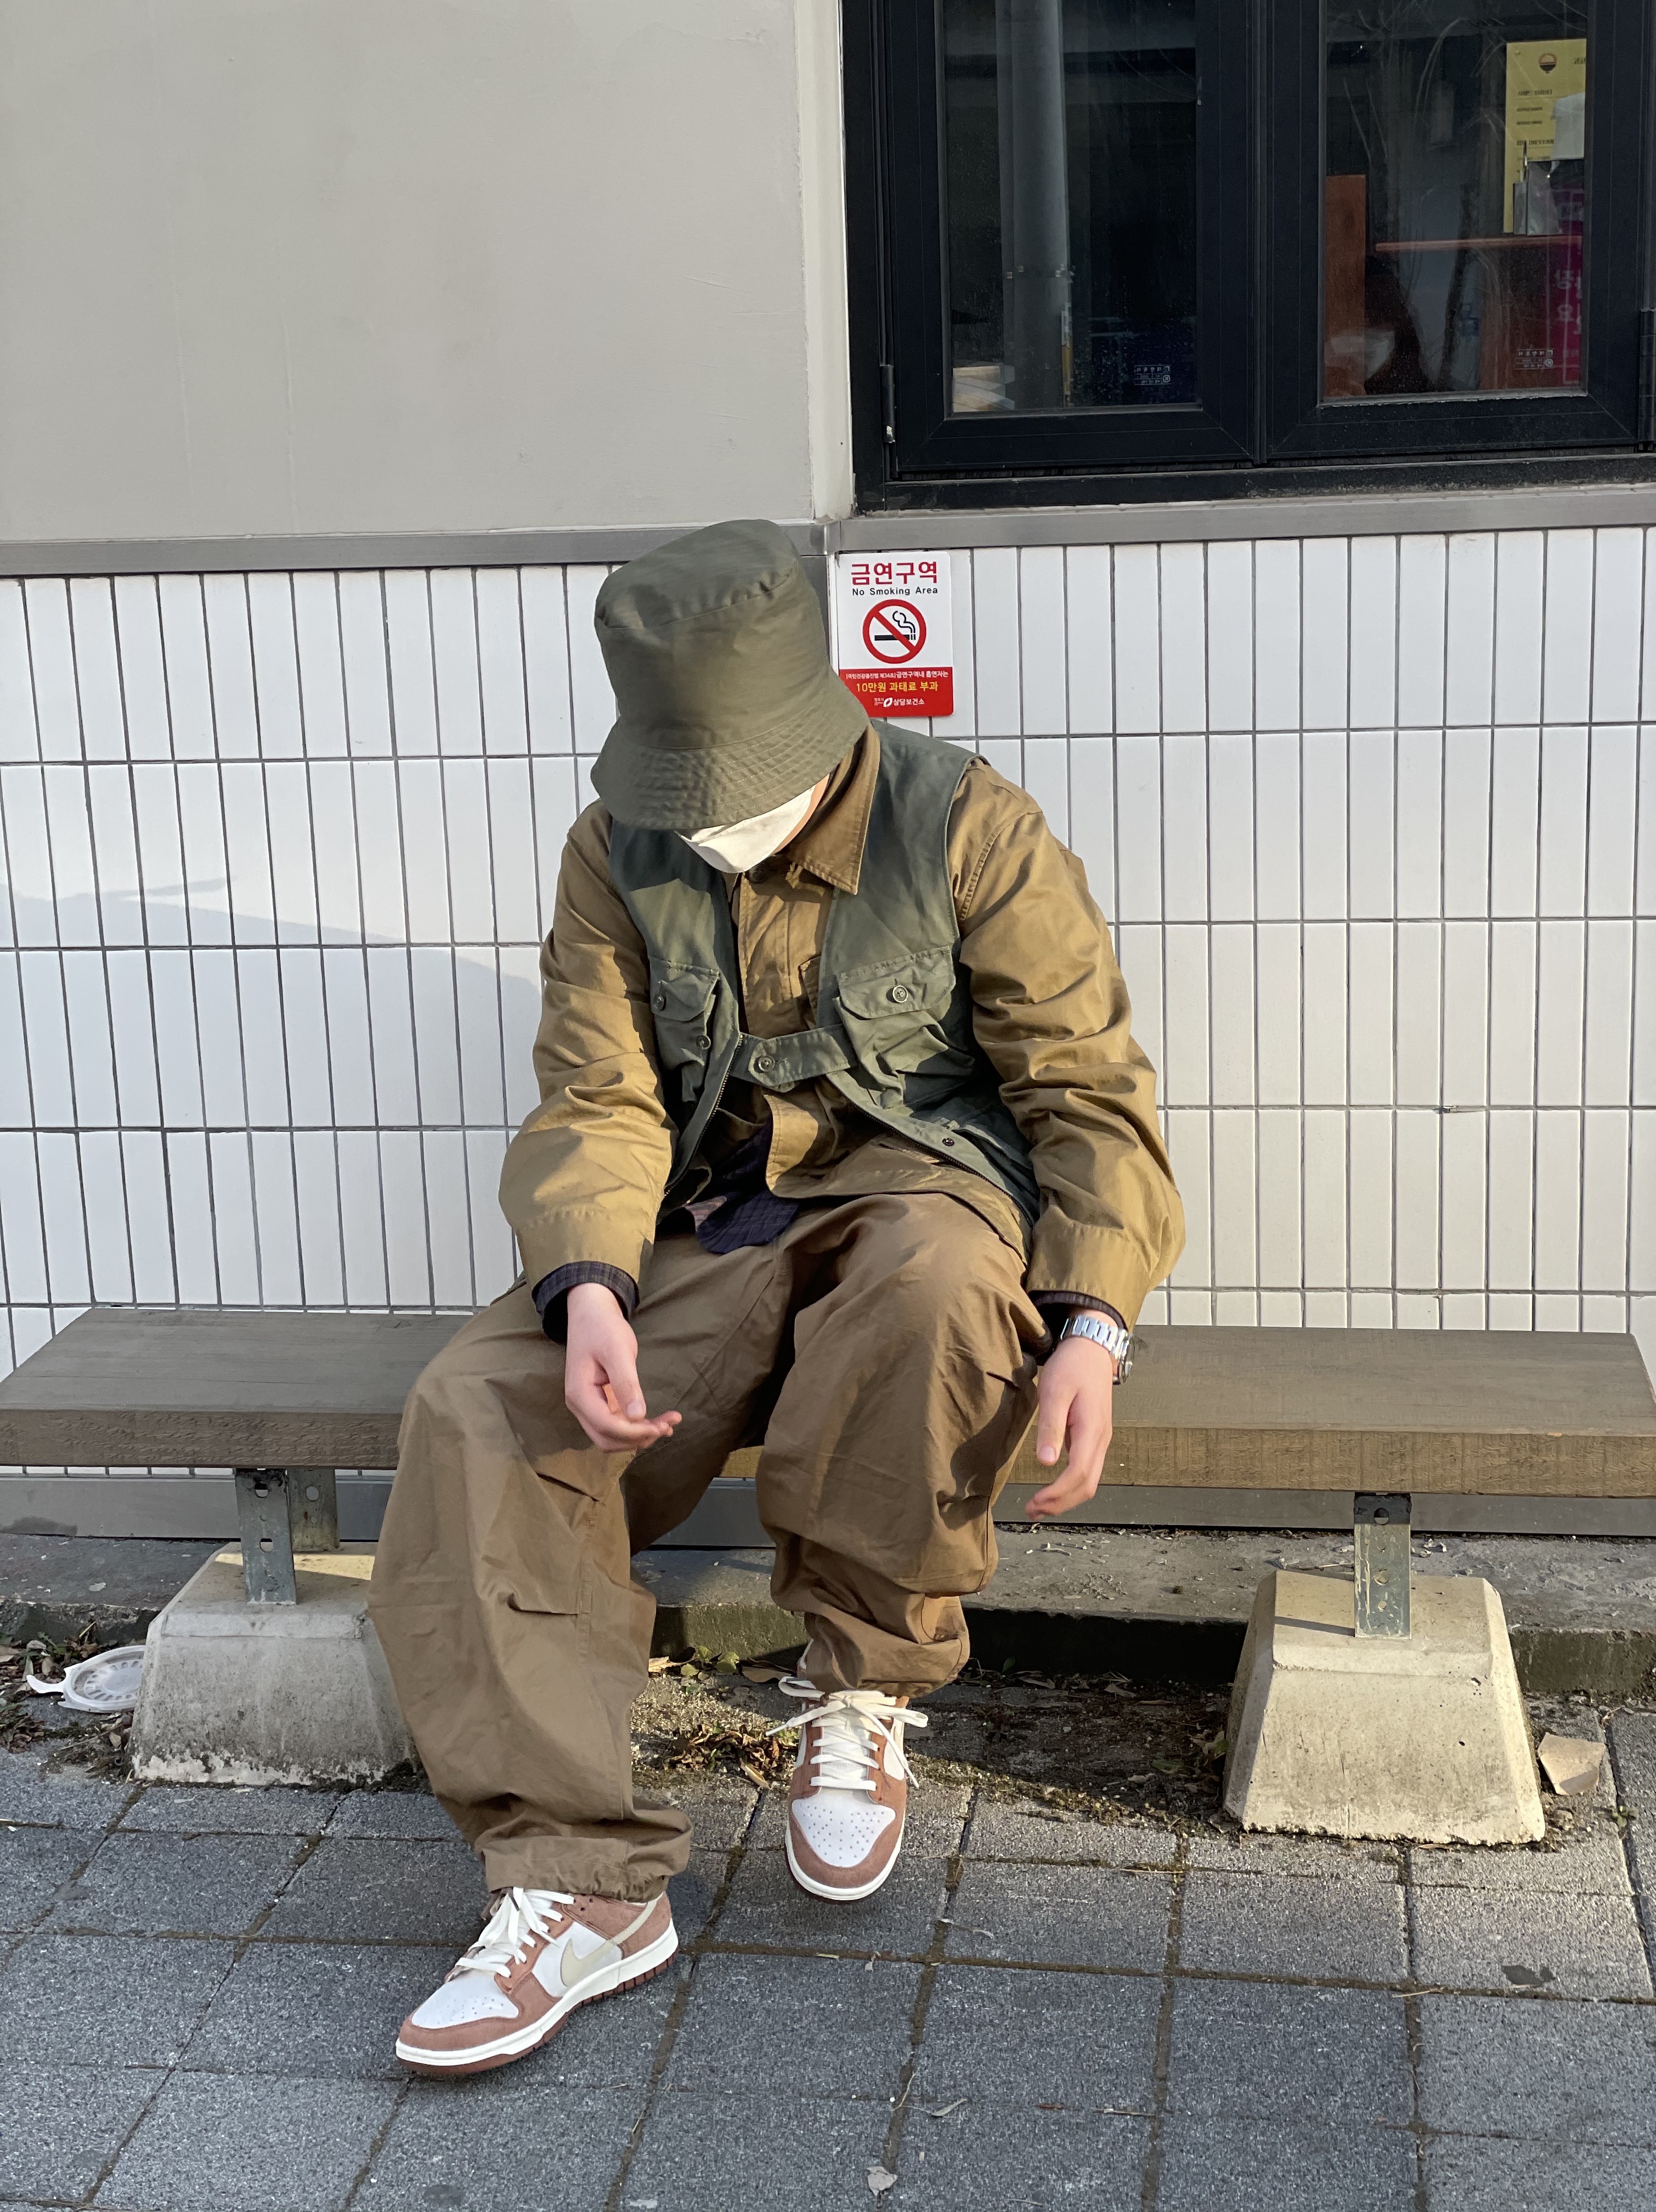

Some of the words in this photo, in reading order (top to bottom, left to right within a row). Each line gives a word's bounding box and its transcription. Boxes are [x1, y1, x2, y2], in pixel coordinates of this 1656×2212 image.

[851, 561, 937, 585] 금연구역
[869, 587, 911, 596] Smoking
[925, 670, 949, 678] 흡연자는
[856, 682, 886, 693] 10만원
[889, 681, 918, 692] 과태료
[919, 681, 939, 692] 부과
[892, 697, 925, 706] 상당보건소
